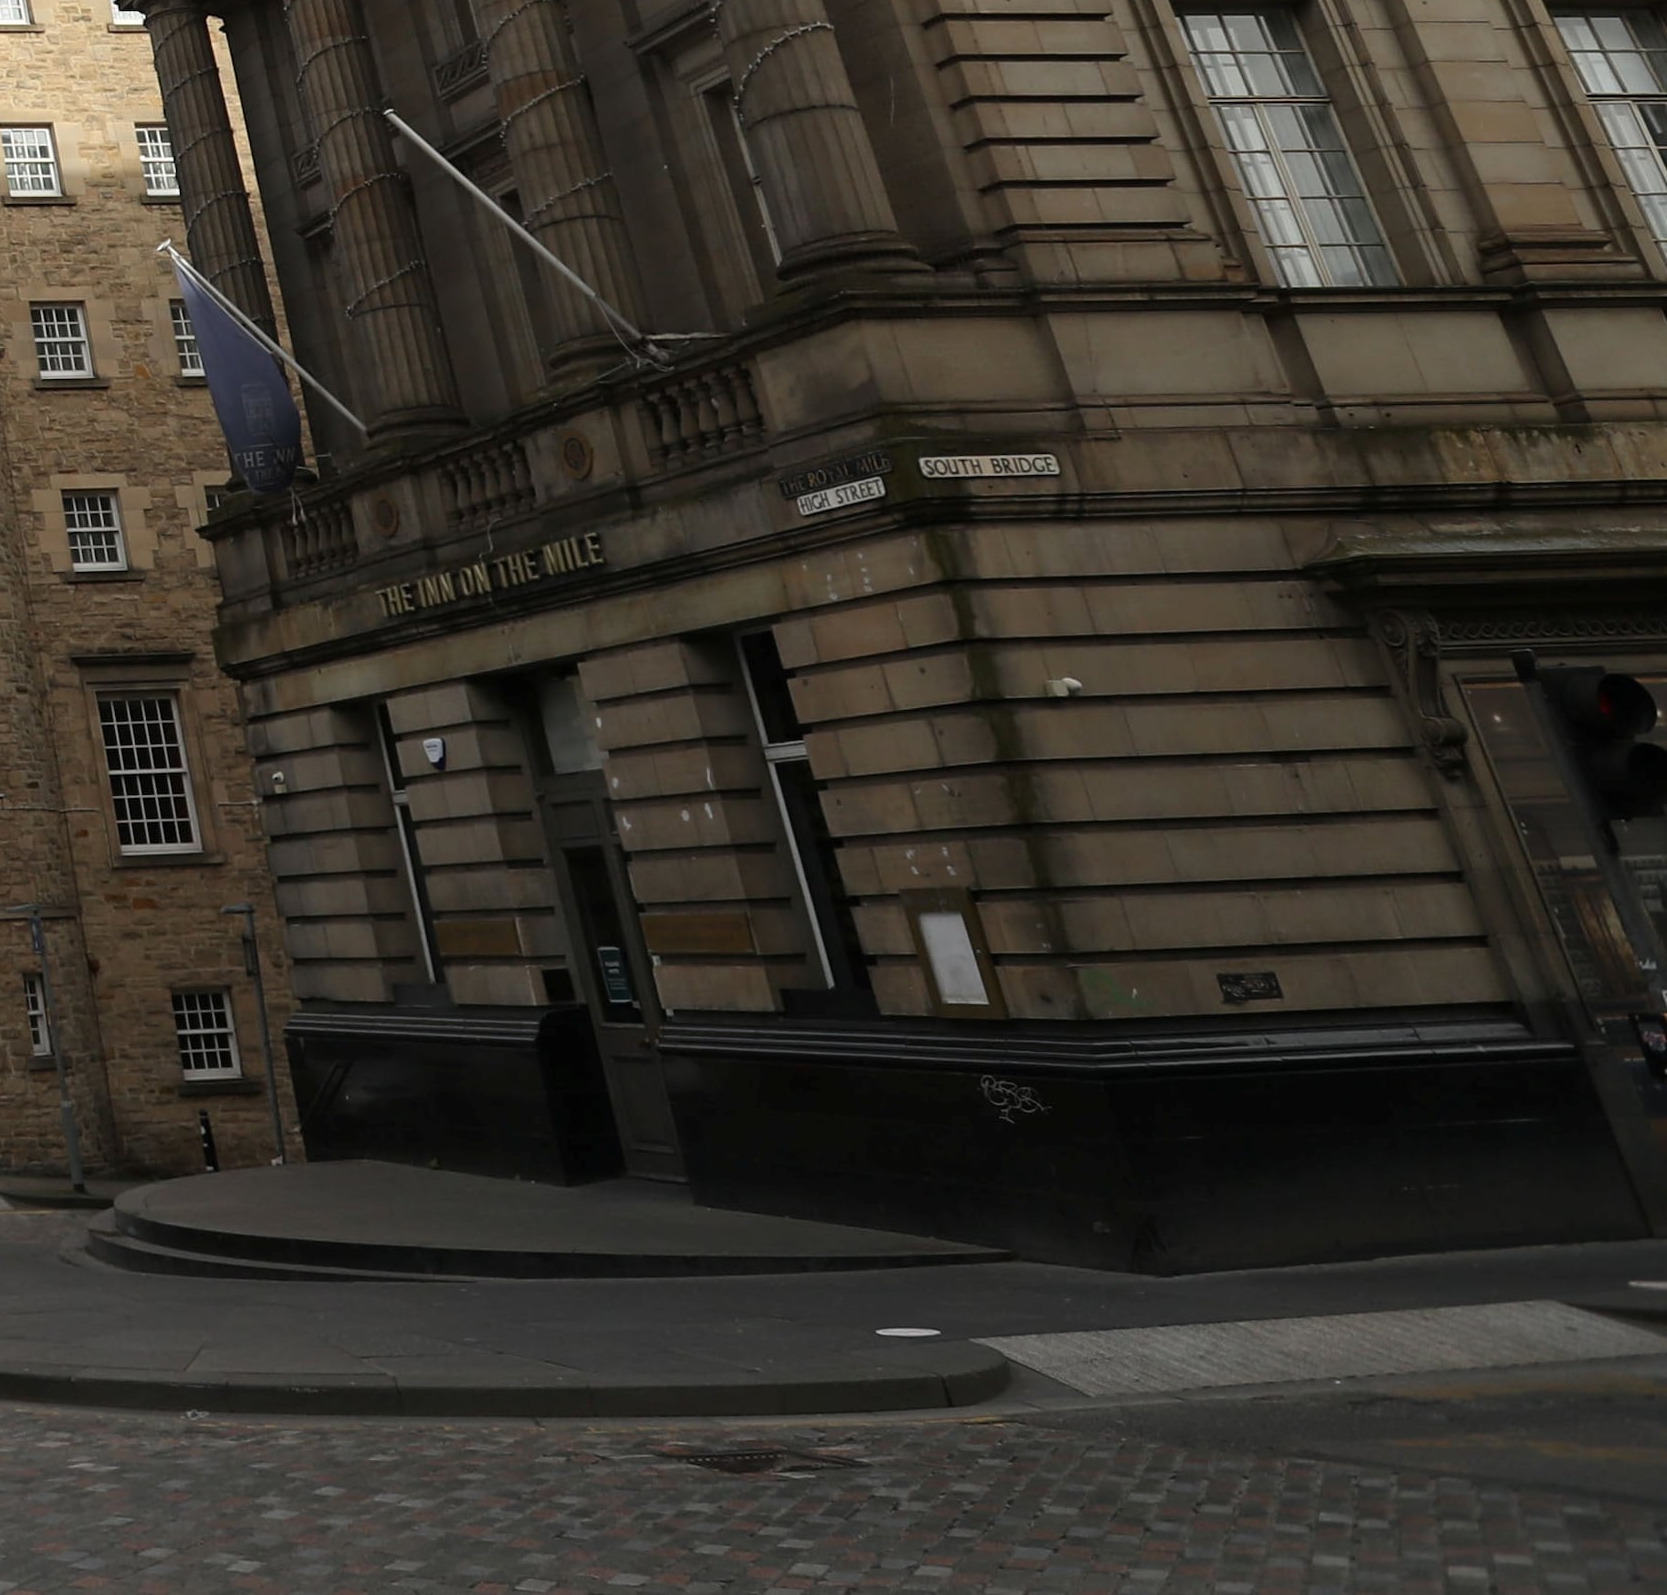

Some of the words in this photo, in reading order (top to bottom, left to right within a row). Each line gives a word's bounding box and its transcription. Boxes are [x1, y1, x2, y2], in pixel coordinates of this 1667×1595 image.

[924, 457, 984, 476] SOUTH
[992, 456, 1057, 474] BRIDGE
[781, 476, 806, 496] THE
[798, 492, 831, 512] HIGH
[835, 479, 884, 505] STREET
[375, 583, 415, 618] THE
[417, 572, 457, 609] INN
[459, 562, 492, 597] ON
[493, 549, 540, 589] THE
[542, 532, 605, 577] MILE
